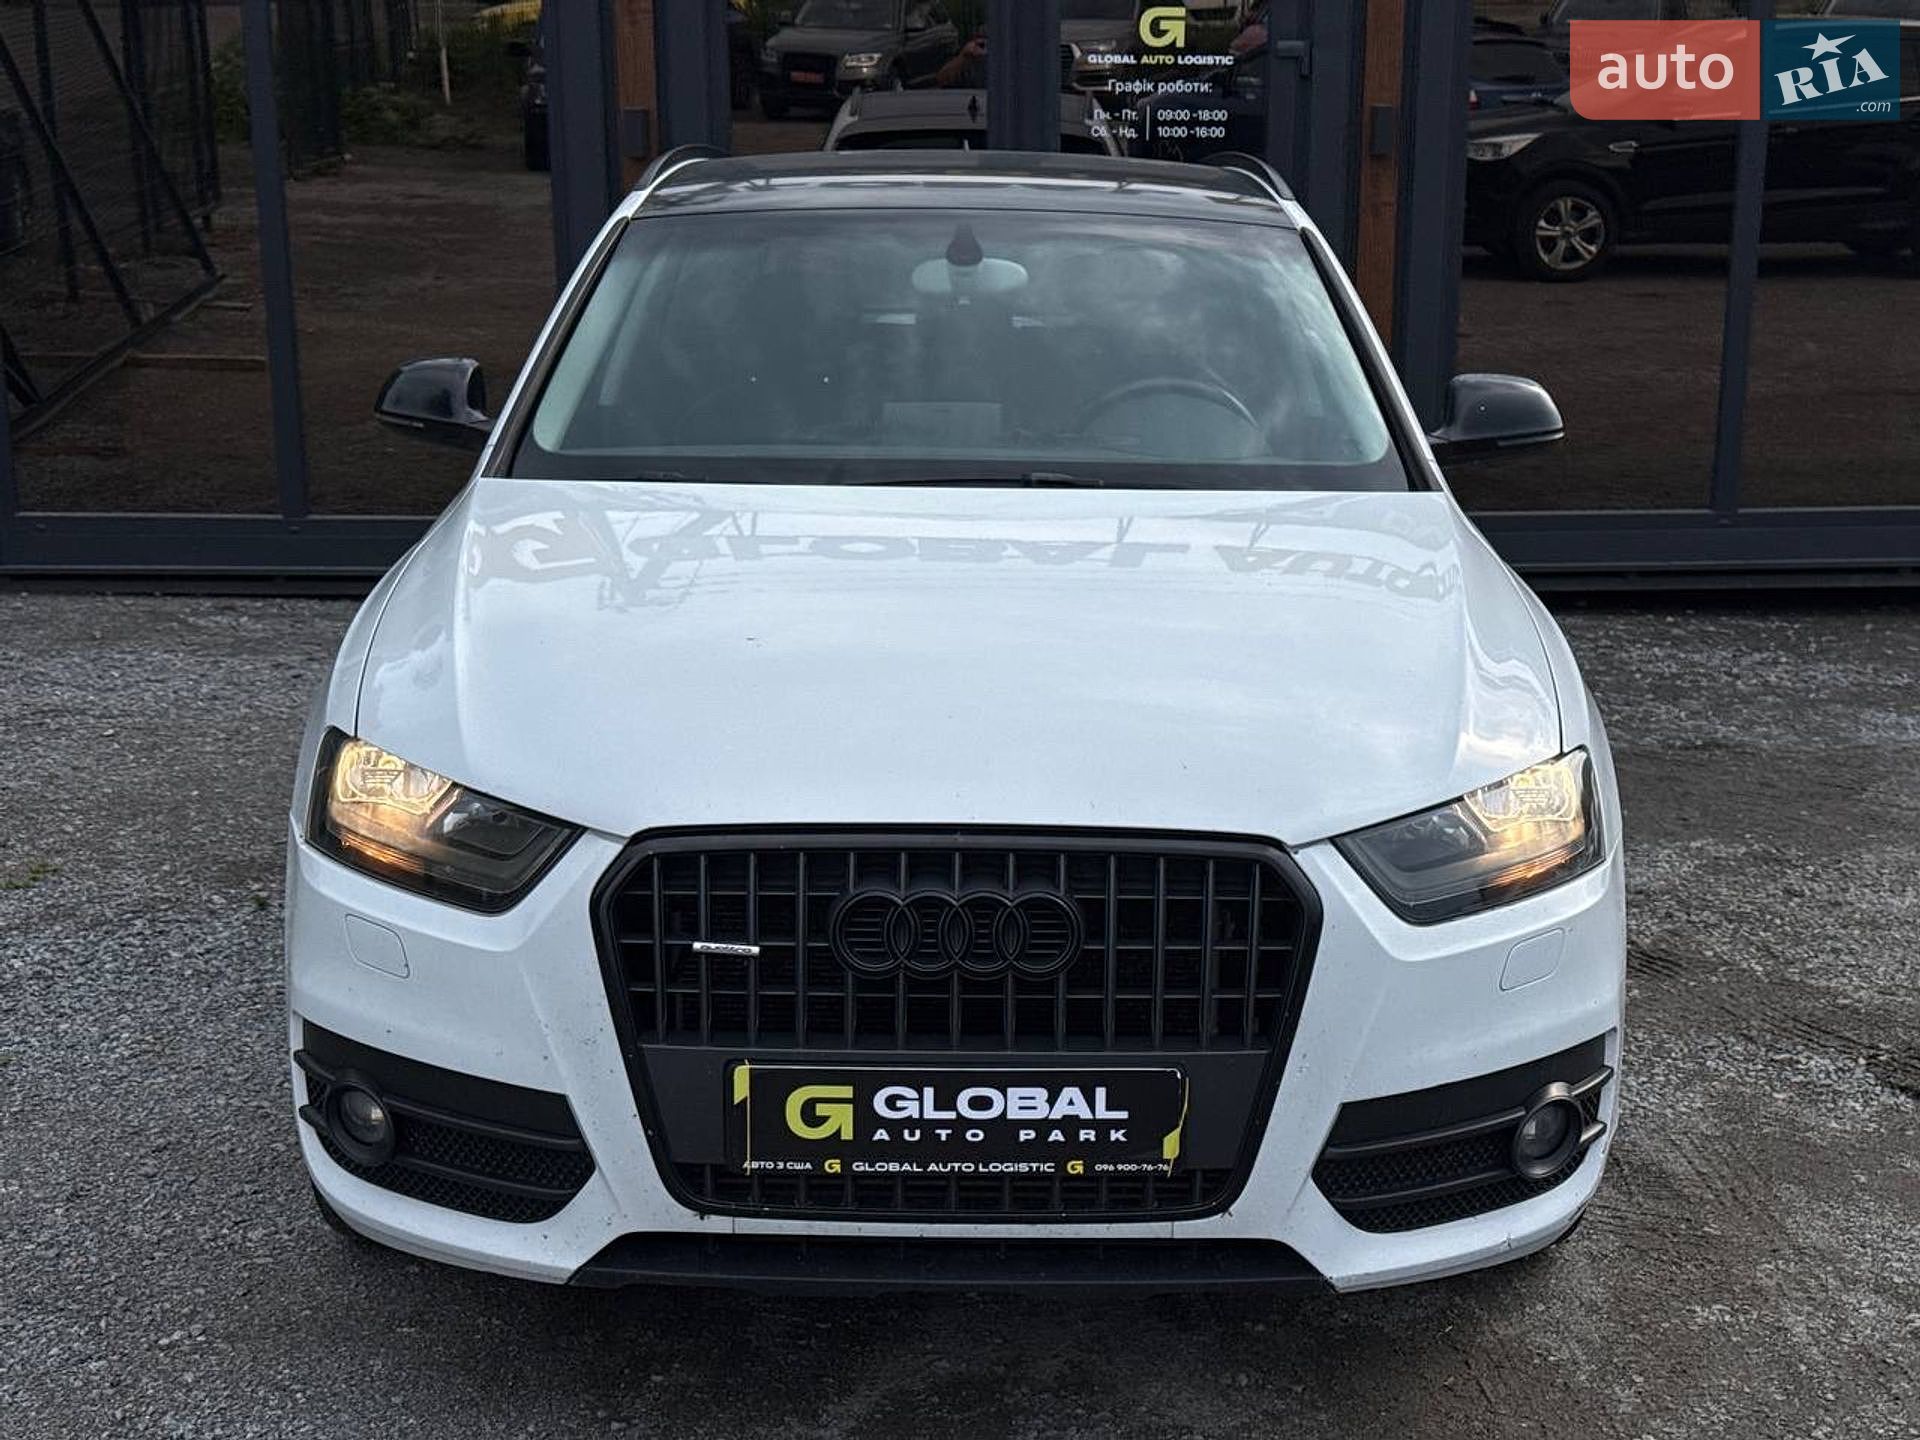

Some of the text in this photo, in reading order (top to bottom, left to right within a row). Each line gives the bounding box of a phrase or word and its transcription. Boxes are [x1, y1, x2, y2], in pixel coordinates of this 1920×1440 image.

[1088, 54, 1234, 65] GLOBAL AUTO LOGISTIC
[1108, 79, 1213, 95] Графік роботи:
[1157, 109, 1190, 121] 09:00
[1157, 126, 1187, 138] 10:00
[873, 1086, 1129, 1119] GLOBAL
[872, 1128, 1128, 1141] AUTO PARK
[786, 1161, 813, 1171] США
[852, 1162, 924, 1172] GLOBAL
[927, 1162, 975, 1173] AUTO
[979, 1162, 1056, 1173] LOGISTIC
[1094, 1163, 1115, 1172] 096
